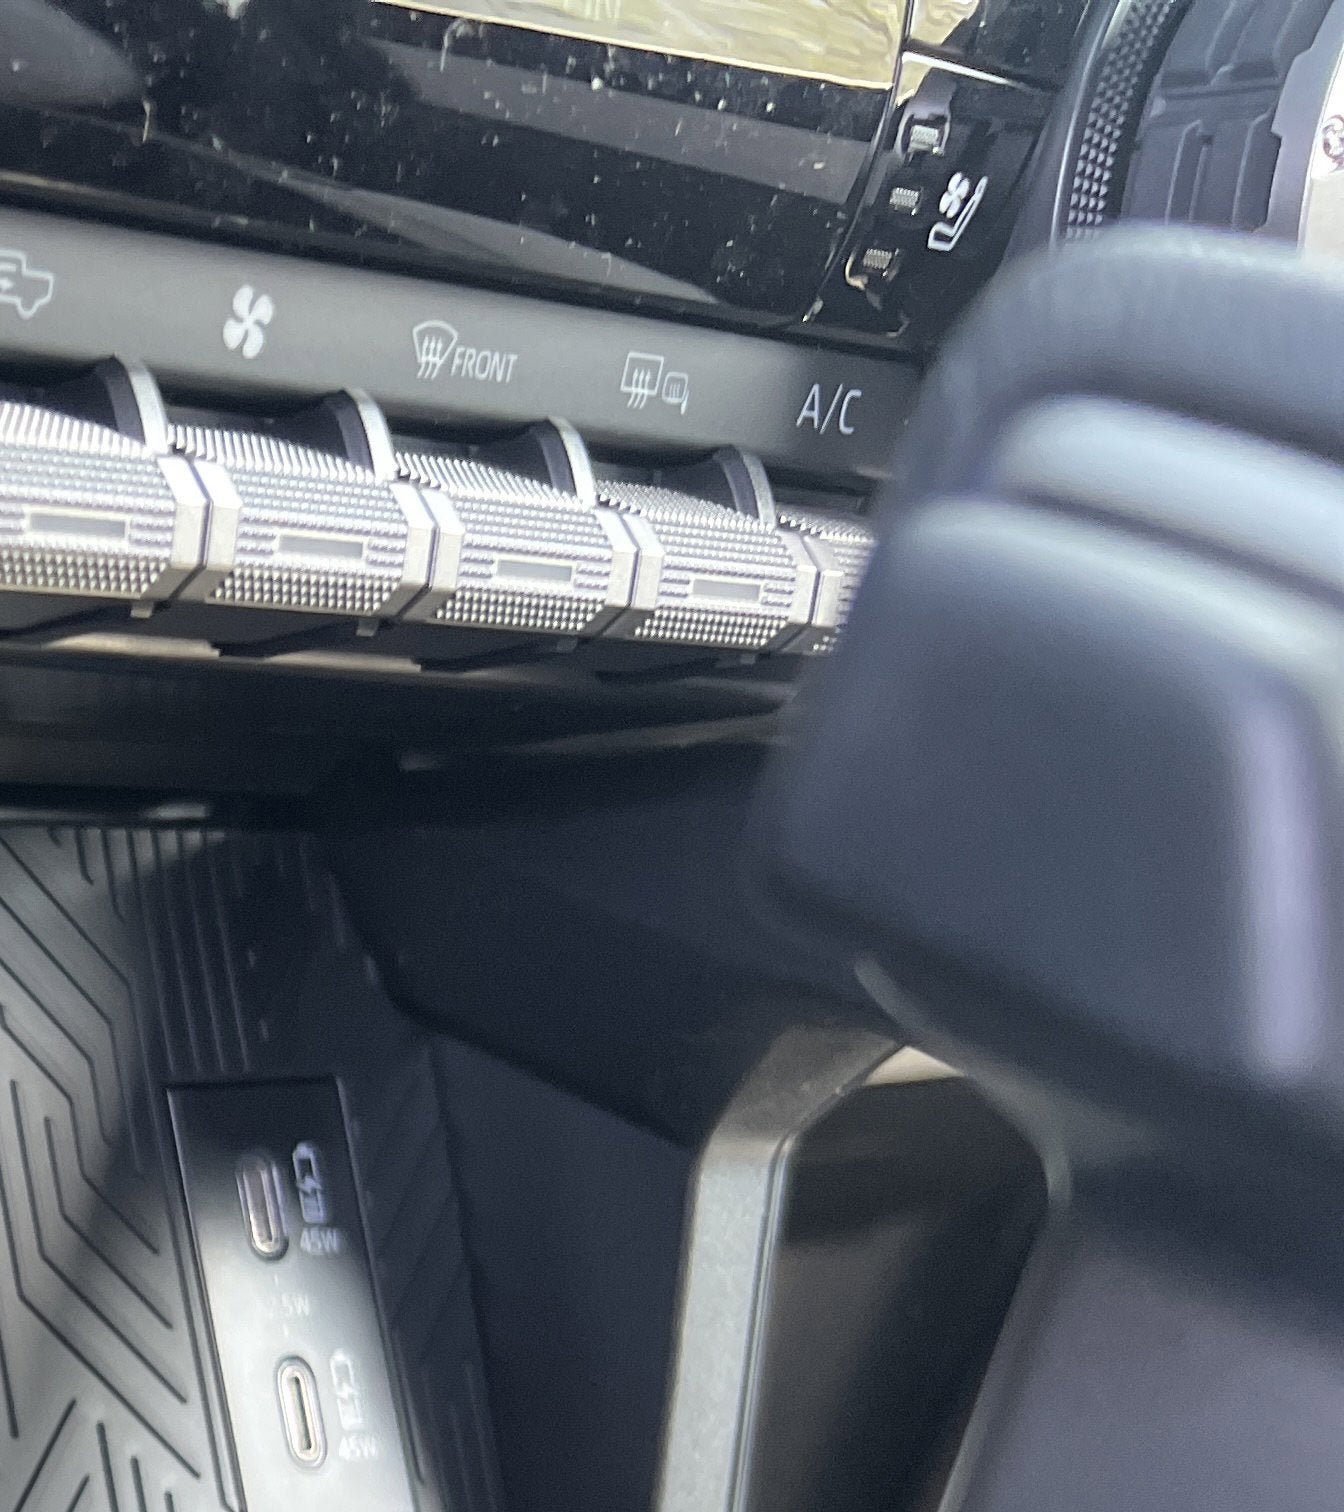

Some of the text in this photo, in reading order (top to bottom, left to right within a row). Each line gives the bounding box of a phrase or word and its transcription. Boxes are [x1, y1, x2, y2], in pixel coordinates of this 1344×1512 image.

[450, 346, 518, 383] FRONT
[796, 383, 862, 435] A/C
[300, 1227, 339, 1255] 45W
[338, 1434, 377, 1461] 45W
